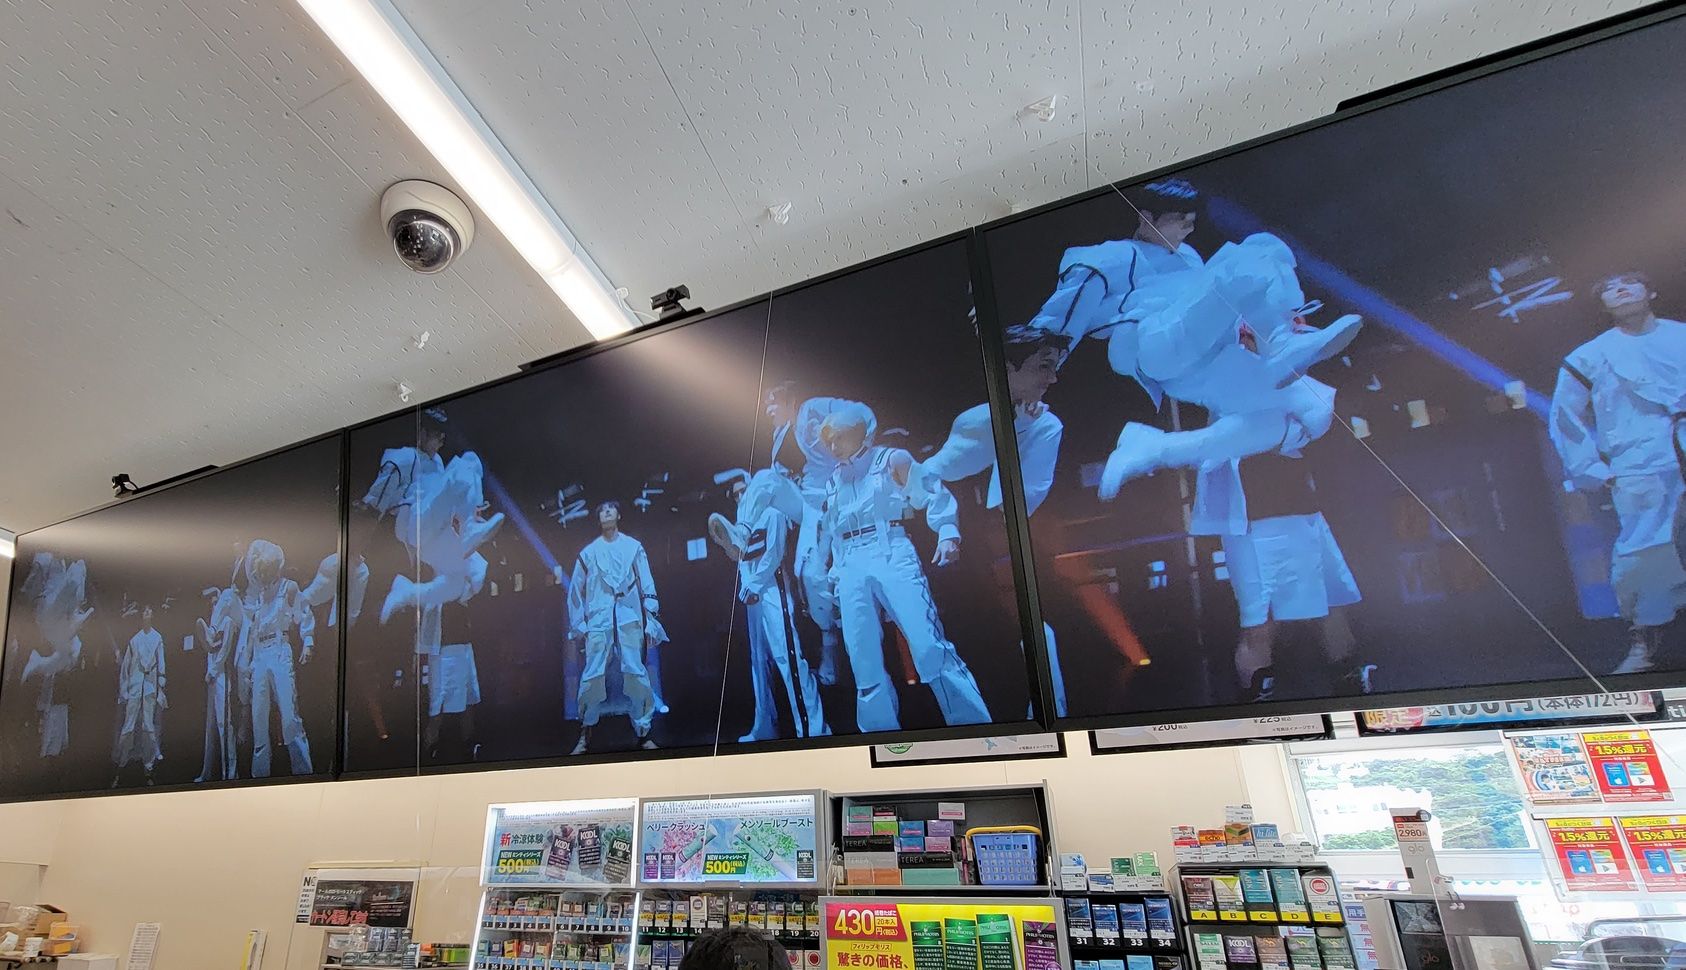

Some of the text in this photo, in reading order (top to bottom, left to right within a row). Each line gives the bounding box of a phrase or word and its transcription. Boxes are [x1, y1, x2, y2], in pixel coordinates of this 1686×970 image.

[647, 822, 705, 832] ベリークラッシュ
[741, 817, 813, 828] メンソールブースト
[580, 830, 598, 840] KOOL
[554, 839, 571, 851] KOOL
[612, 840, 631, 853] KOOL
[498, 858, 523, 873] 500
[706, 861, 730, 873] 500
[835, 910, 875, 935] 430
[876, 927, 882, 935] 円
[1158, 939, 1171, 947] 34
[1229, 939, 1251, 947] KOOL
[837, 952, 908, 969] 驚きの価格、
